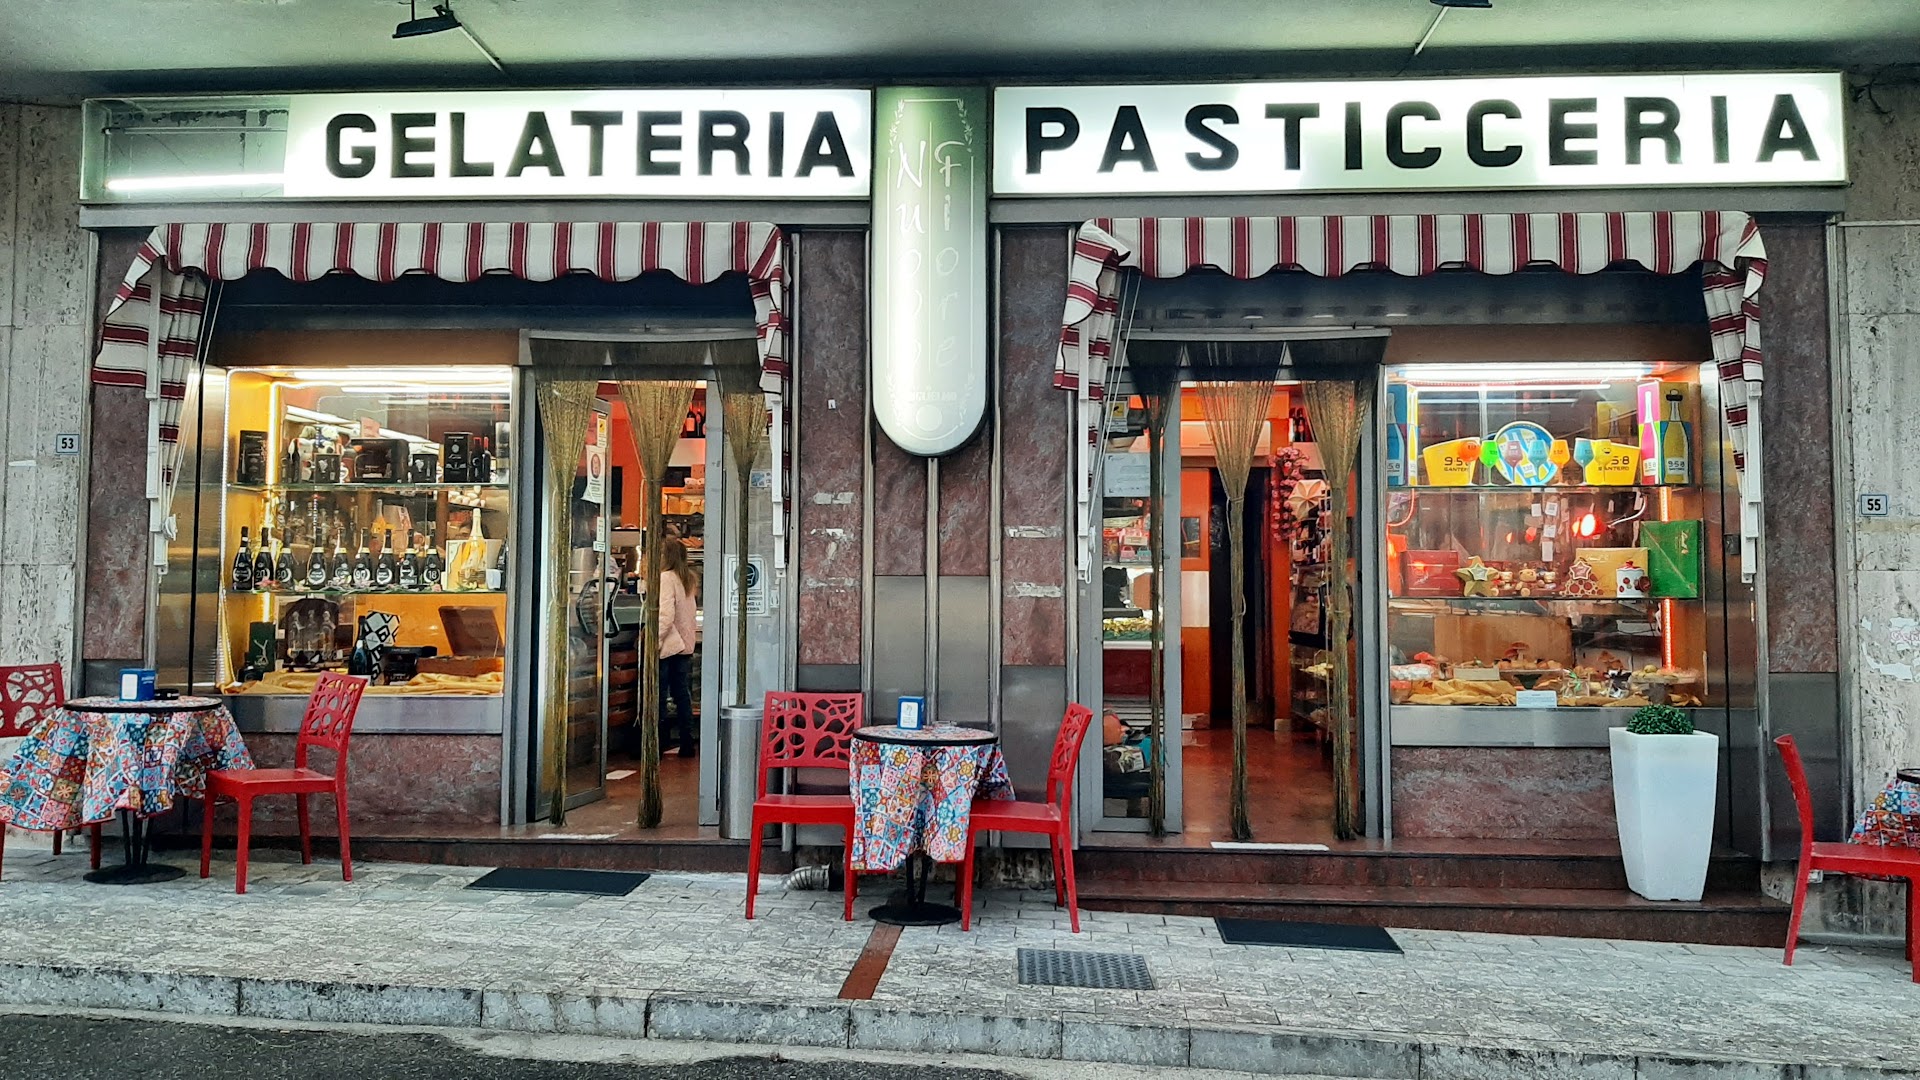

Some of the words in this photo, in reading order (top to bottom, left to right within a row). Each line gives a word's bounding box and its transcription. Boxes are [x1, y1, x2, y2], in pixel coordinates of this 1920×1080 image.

[1025, 94, 1817, 174] PASTICCERIA
[326, 110, 855, 179] GELATERIA
[904, 389, 958, 401] GLIELMO
[61, 437, 75, 450] 53
[1867, 498, 1882, 511] 55
[428, 570, 438, 579] 18
